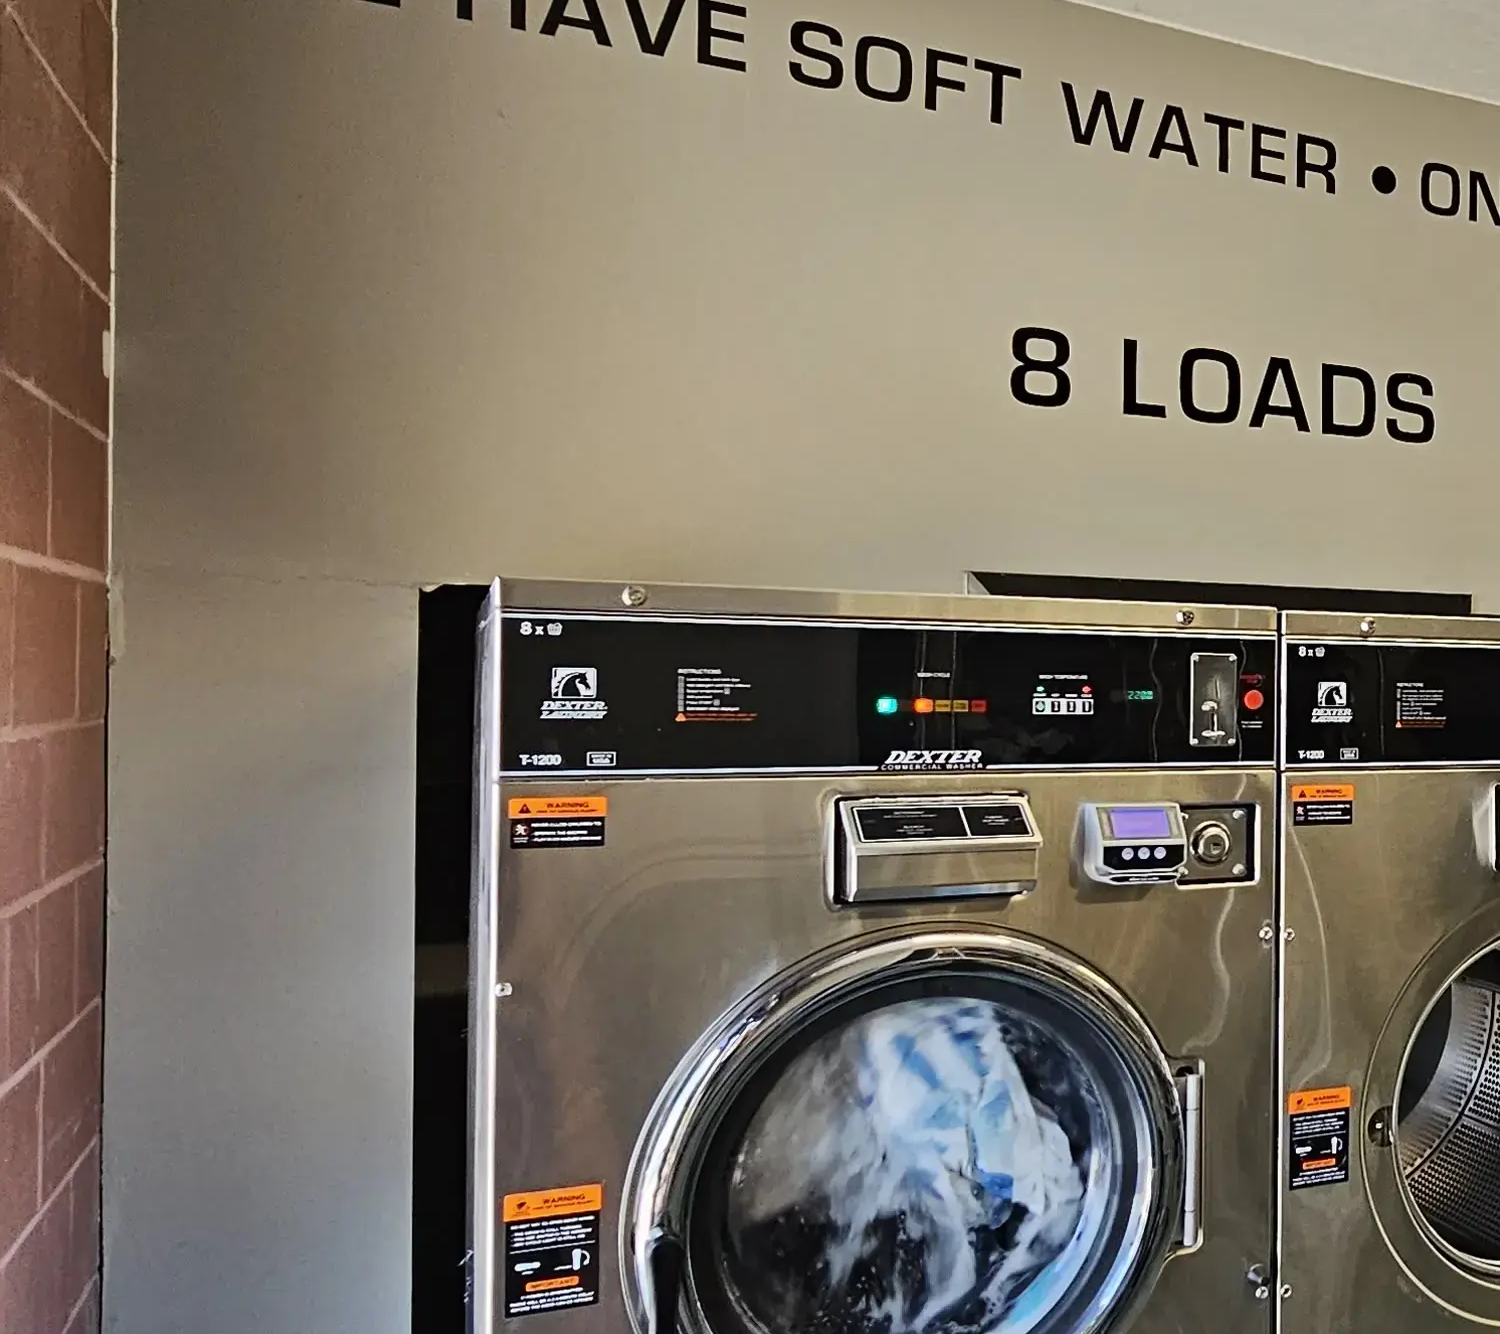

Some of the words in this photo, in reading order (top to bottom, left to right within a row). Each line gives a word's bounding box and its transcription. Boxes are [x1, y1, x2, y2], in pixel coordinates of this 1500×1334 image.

[789, 20, 1022, 125] SOFT
[1061, 81, 1337, 195] WATER
[1010, 327, 1071, 407] 8
[1123, 338, 1435, 444] LOADS
[519, 621, 532, 636] 8
[540, 701, 607, 710] DEXTER
[519, 754, 562, 767] T-1200
[884, 749, 982, 764] DEXTER
